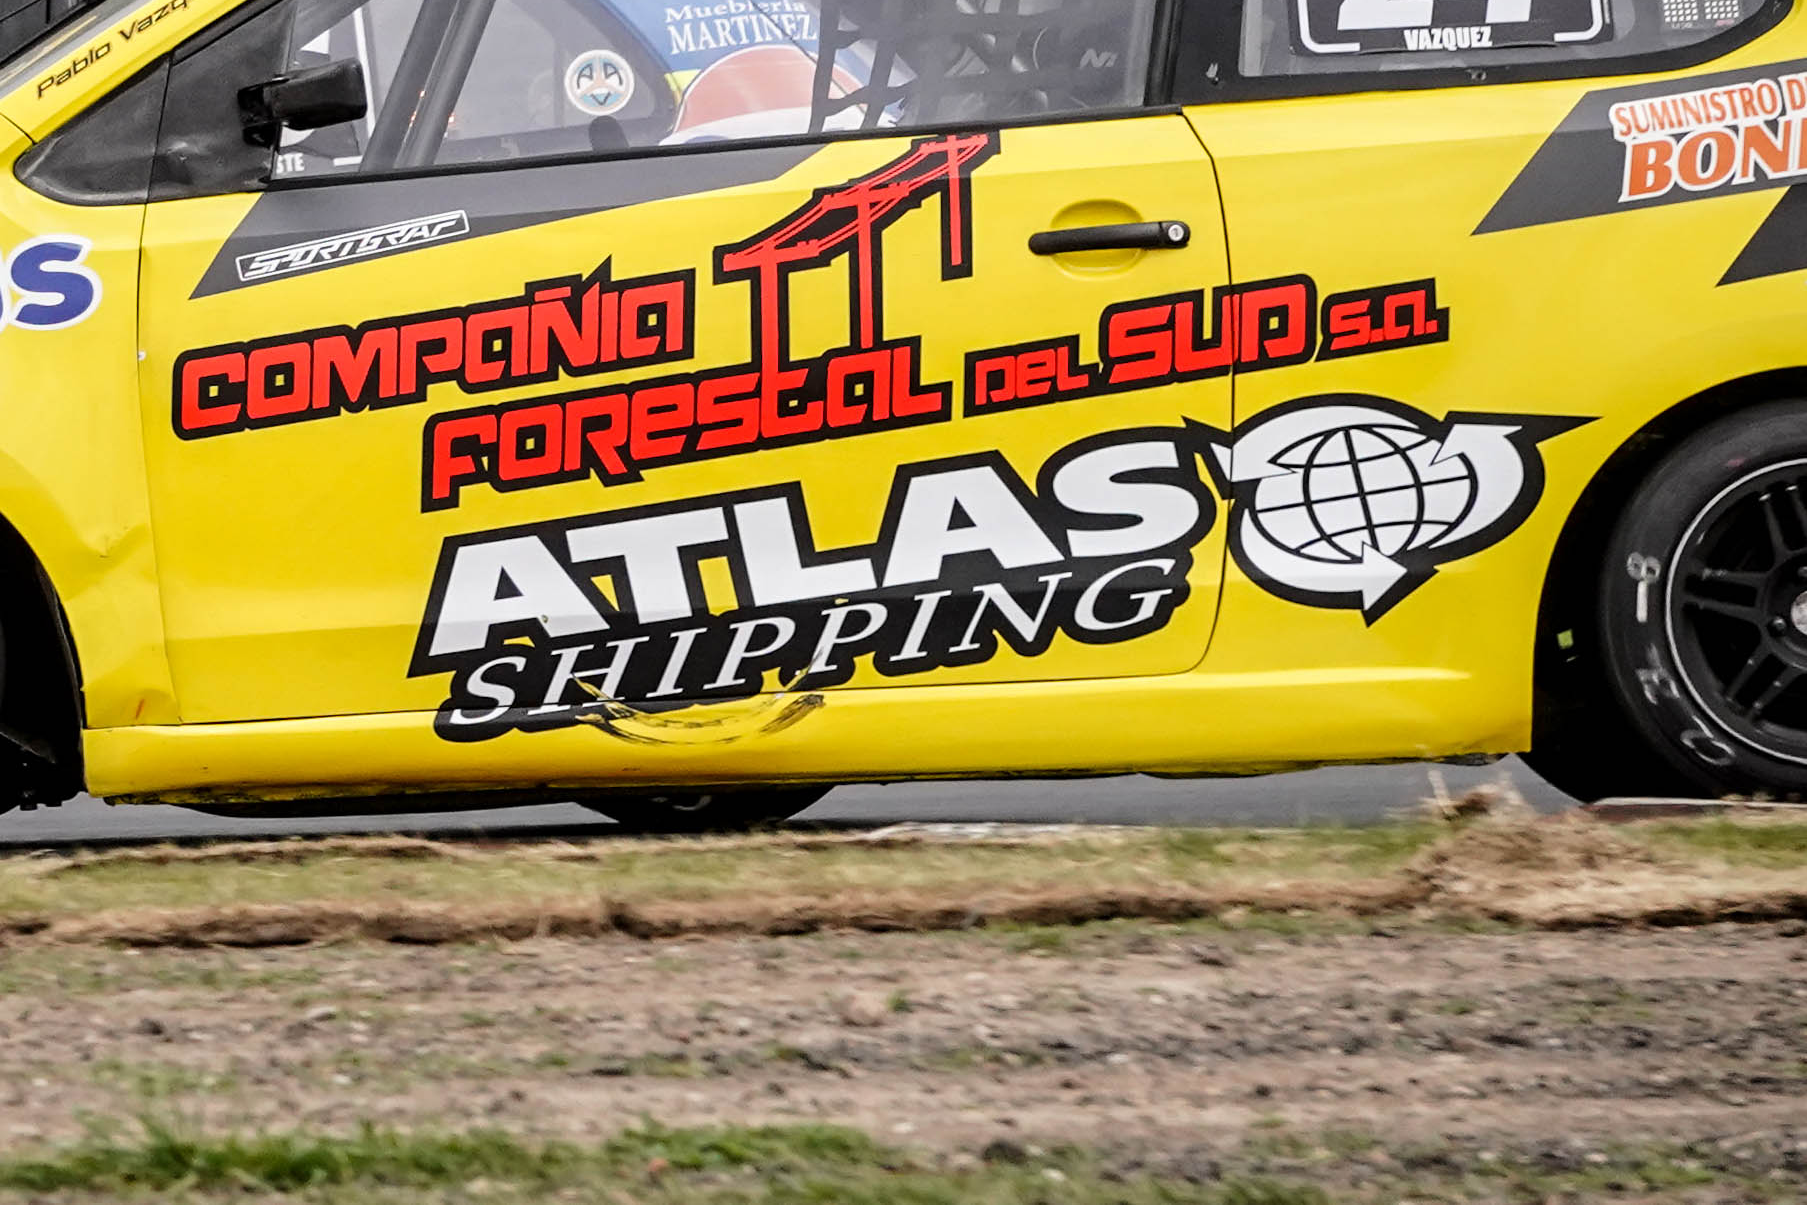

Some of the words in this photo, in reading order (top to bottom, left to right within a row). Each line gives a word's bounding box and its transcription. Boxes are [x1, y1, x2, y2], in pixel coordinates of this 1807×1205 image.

[666, 13, 819, 56] MARTINEZ
[1403, 26, 1492, 52] VAZQUEZ
[37, 41, 112, 99] Pablo
[1614, 81, 1779, 138] SUMINISTRO
[1626, 115, 1807, 197] BON
[243, 212, 463, 278] SPORTGRAF
[1108, 282, 1308, 385] SUD
[427, 439, 1201, 657] ATLAS
[448, 556, 1176, 726] SHIPPING
